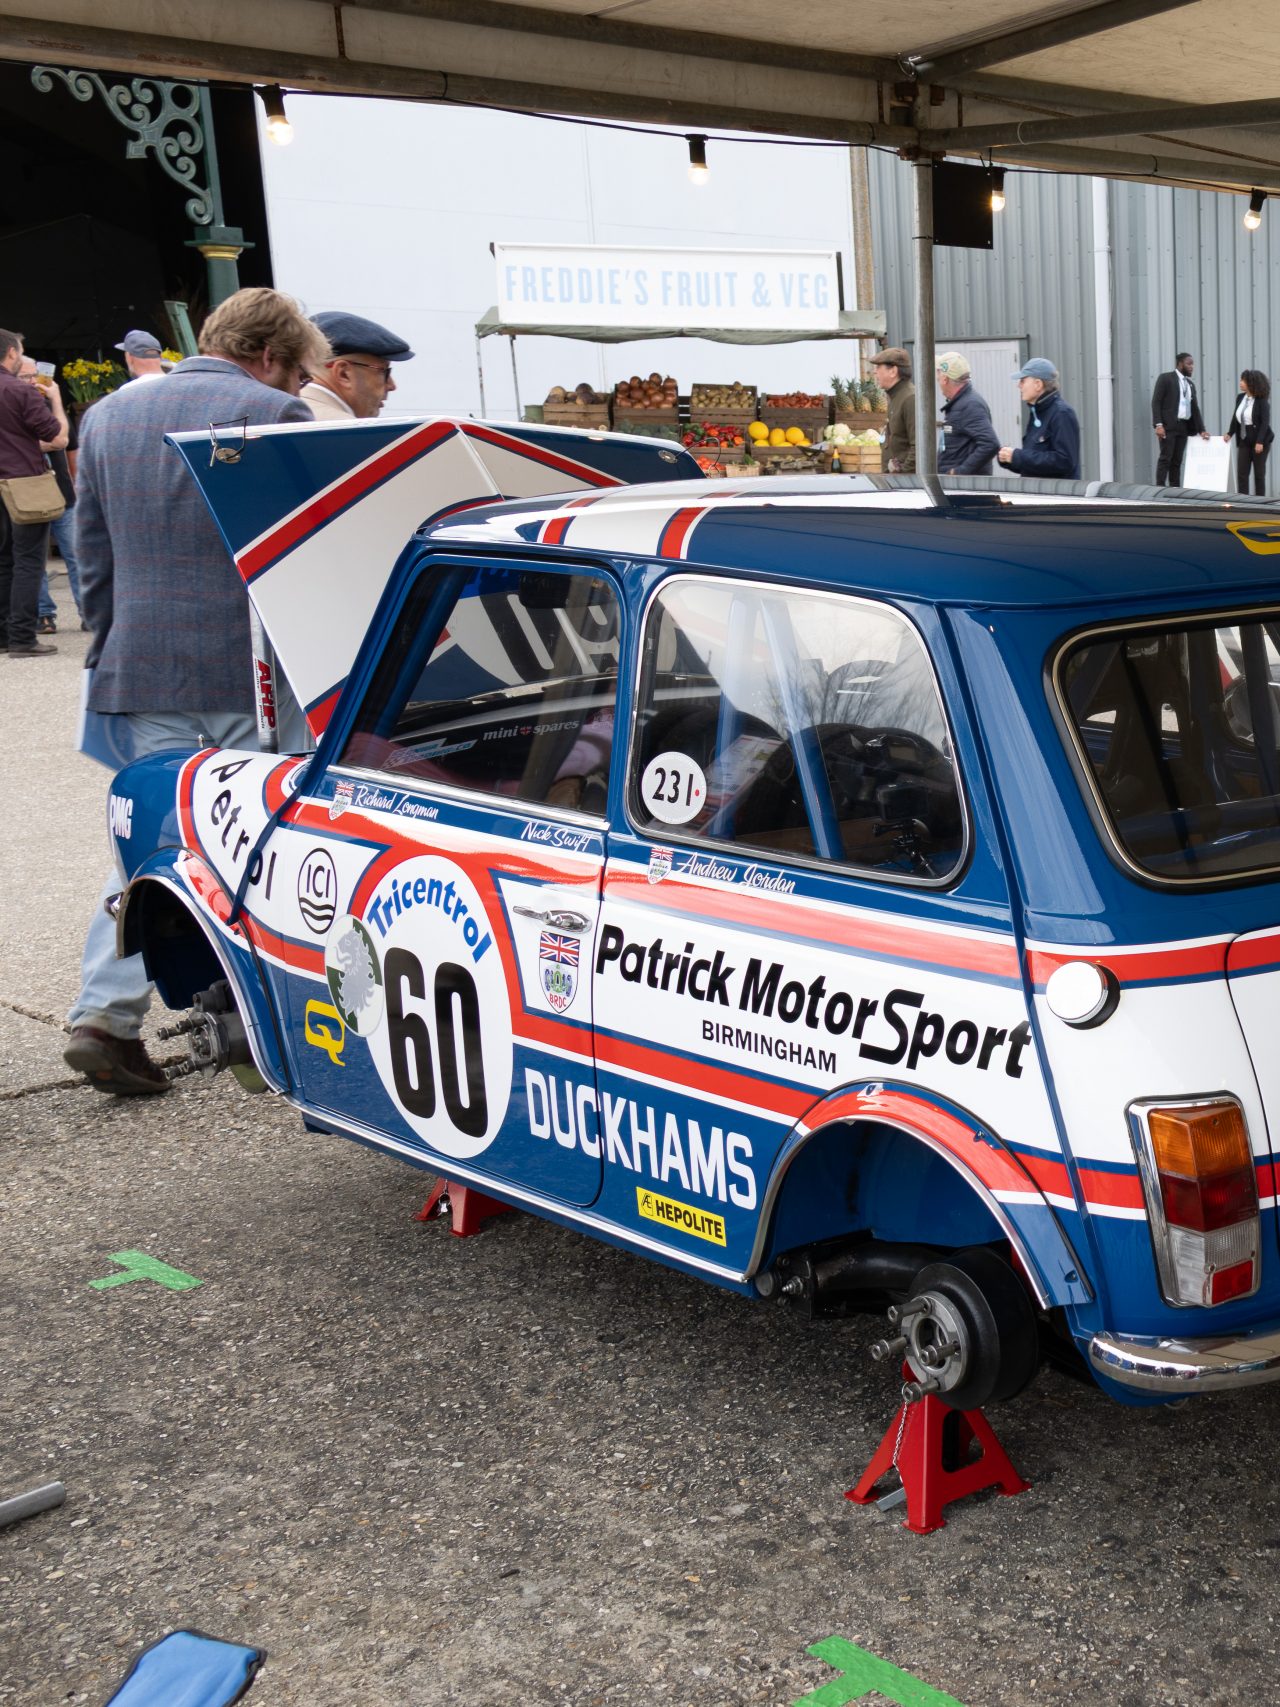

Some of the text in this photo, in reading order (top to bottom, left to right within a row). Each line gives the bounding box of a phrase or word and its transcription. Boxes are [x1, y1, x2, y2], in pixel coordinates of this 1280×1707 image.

[506, 265, 828, 309] FREDDIE'S FRUIT & VEG
[483, 719, 580, 742] mini spares
[355, 785, 439, 820] Richard Longman
[652, 767, 694, 806] 231
[109, 794, 133, 840] PMG
[520, 821, 593, 852] Nick Swift
[306, 864, 331, 899] ICI
[677, 852, 796, 894] Andrew Jordan
[367, 877, 492, 963] Tricentrol
[595, 924, 737, 1007] Patrick
[549, 993, 567, 1009] BRDC
[384, 946, 489, 1139] 60
[702, 1019, 837, 1074] BIRMINGHAM
[524, 1067, 757, 1211] DUCKHAMS
[655, 1199, 724, 1239] HEPOLITE
